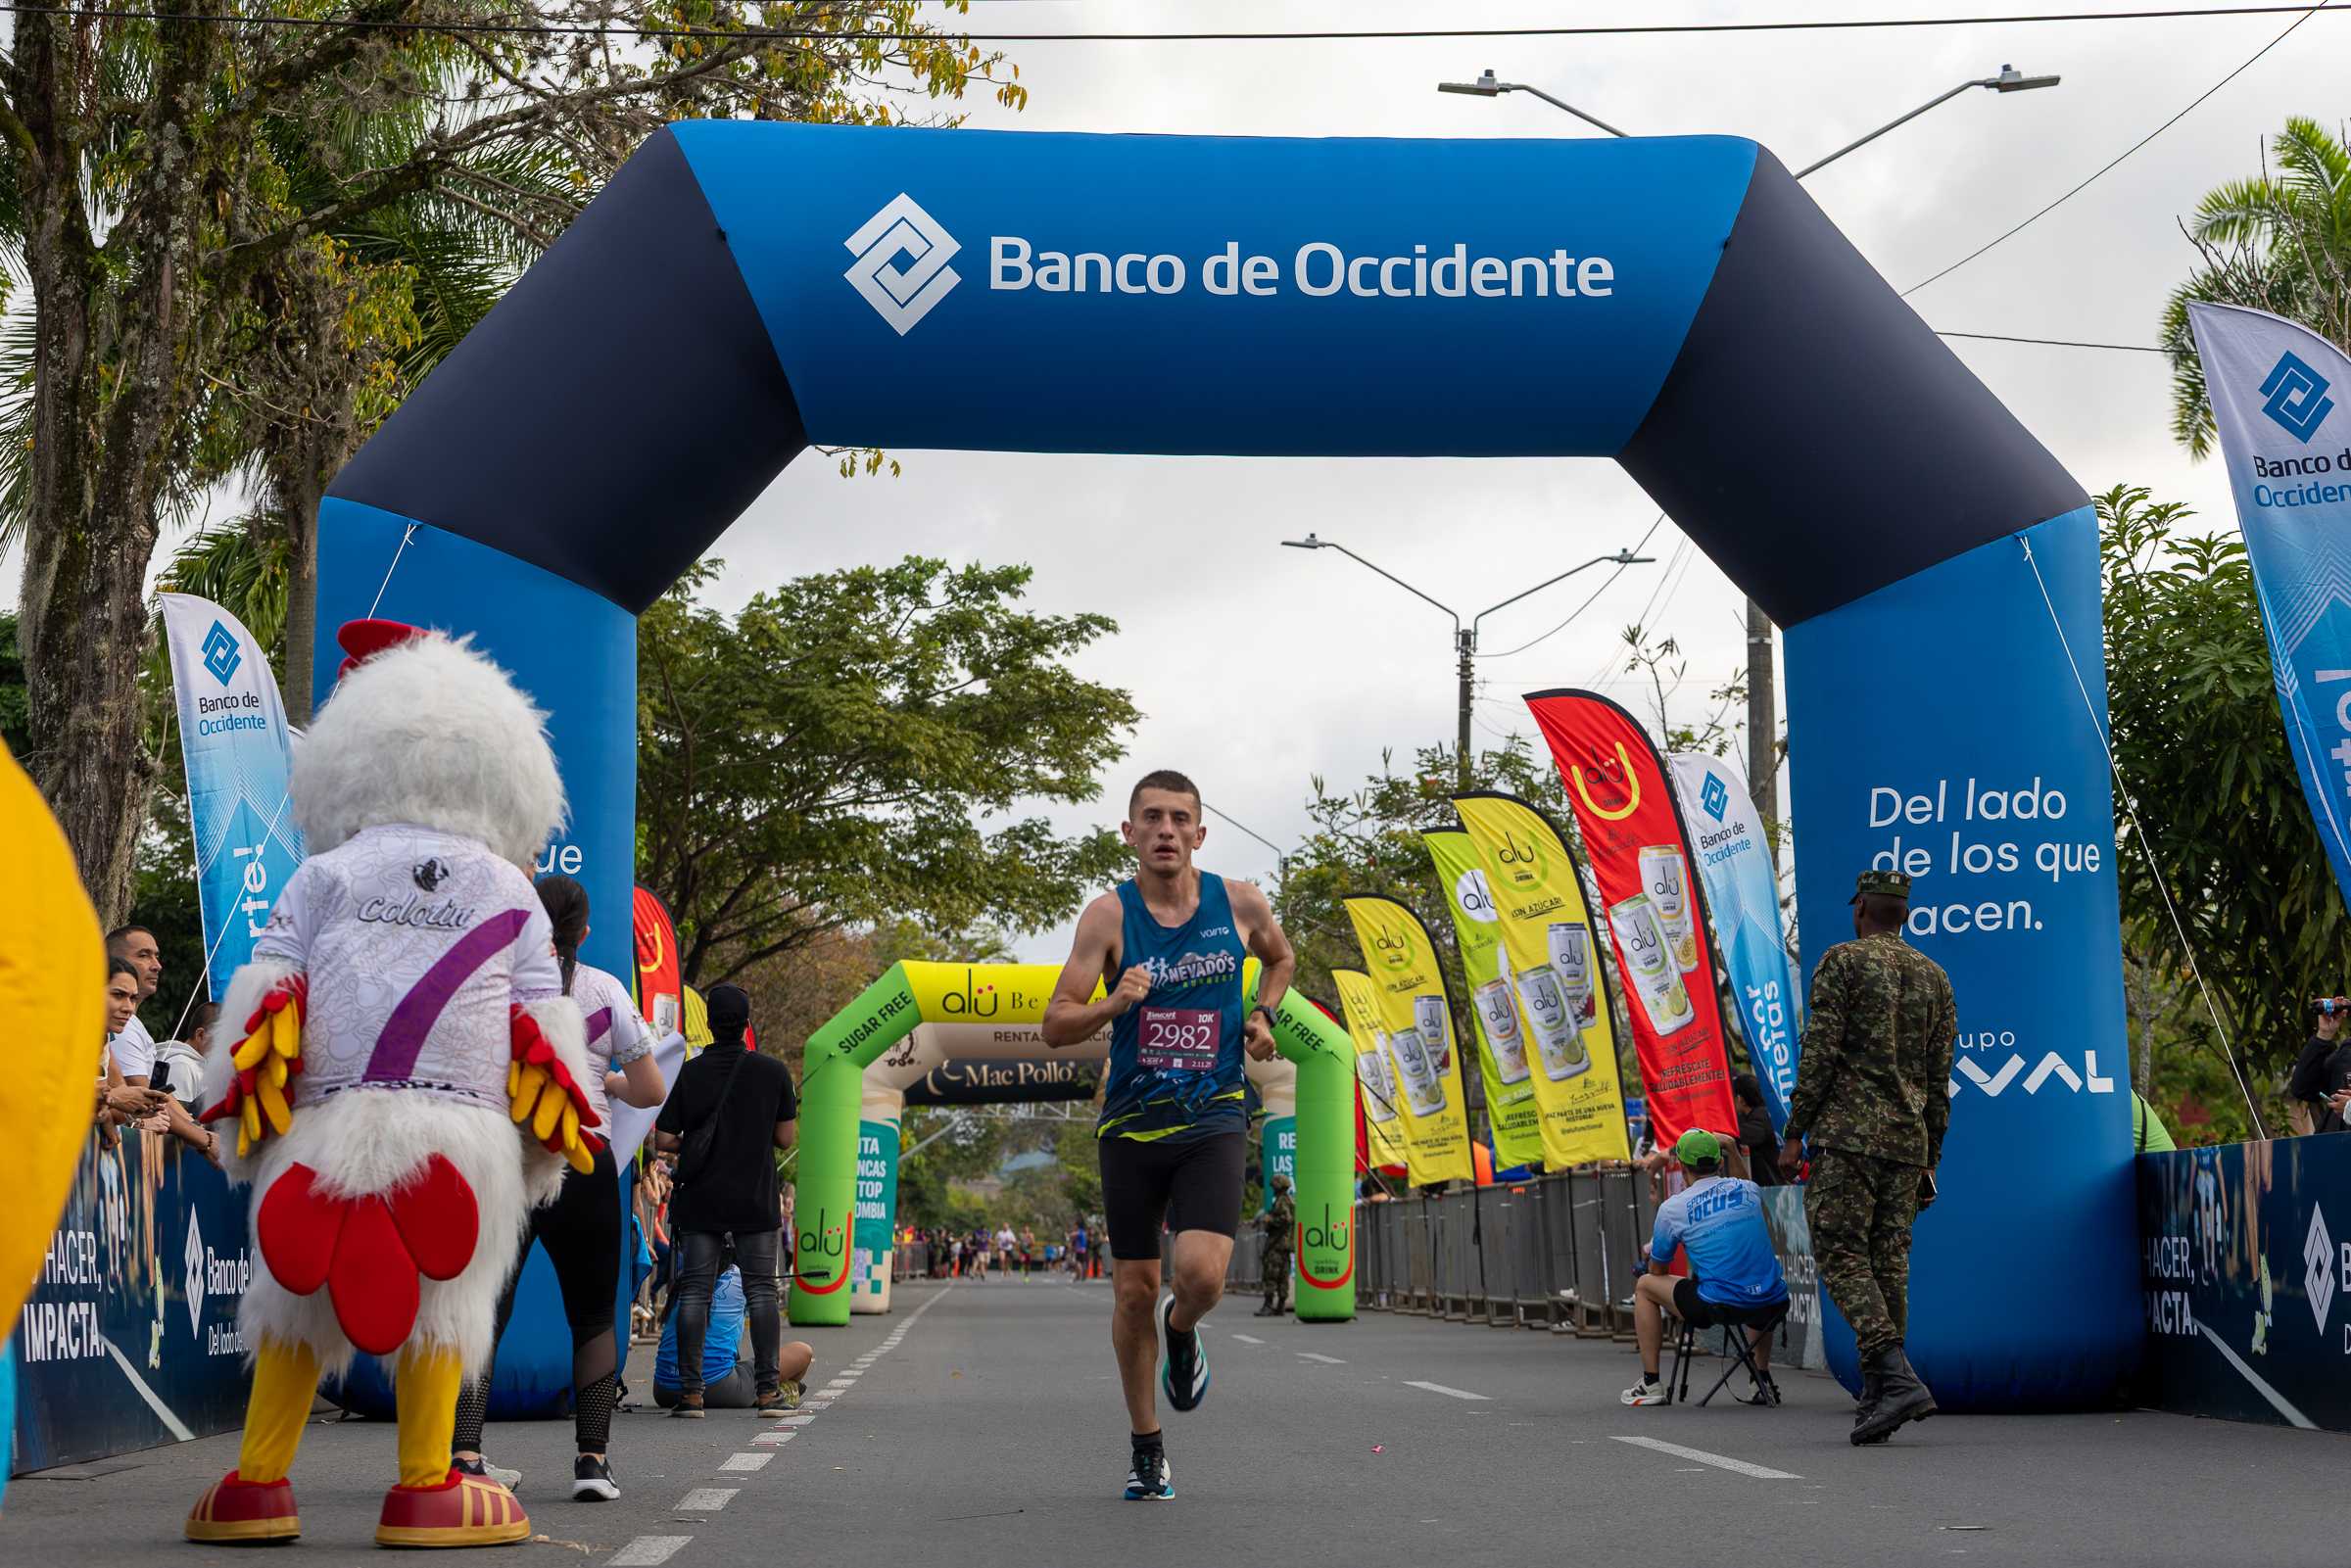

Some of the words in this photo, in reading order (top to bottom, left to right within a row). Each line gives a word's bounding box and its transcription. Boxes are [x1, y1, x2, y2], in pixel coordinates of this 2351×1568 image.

[989, 235, 1185, 295] Banco
[1202, 241, 1279, 296] de
[1295, 242, 1614, 298] Occidente
[2253, 454, 2330, 478] Banco
[2336, 448, 2351, 471] d
[2254, 481, 2351, 507] Occiden
[199, 696, 239, 714] Banco
[242, 691, 260, 708] de
[199, 714, 266, 736] Occidente
[1869, 780, 1946, 828] Del
[1965, 777, 2067, 821] lado
[1701, 829, 1732, 849] Banco
[1733, 822, 1745, 835] de
[535, 844, 583, 875] ue
[1872, 836, 1932, 878] de
[1950, 832, 2019, 875] los
[2035, 842, 2100, 882] que
[233, 844, 268, 937] rte!
[1899, 900, 2043, 936] acen.
[1169, 956, 1236, 983] NEVADO'S
[942, 968, 998, 1017] alü
[839, 1017, 882, 1055] SUGAR
[878, 990, 912, 1022] FREE
[1198, 1013, 1215, 1023] 10K
[1148, 1022, 1212, 1050] 2982
[1290, 1021, 1324, 1052] FREE
[1959, 1031, 2015, 1052] upo
[965, 1064, 1014, 1087] Mac
[1017, 1061, 1074, 1084] Pollo
[1278, 1132, 1296, 1150] RE
[856, 1160, 887, 1177] NCAS
[1272, 1155, 1293, 1172] LAS
[854, 1202, 887, 1219] OMBIA
[800, 1208, 843, 1257] alü
[1306, 1204, 1347, 1251] alü
[45, 1229, 102, 1293] HACER,
[207, 1246, 236, 1295] Banco
[238, 1247, 249, 1295] de
[2152, 1291, 2198, 1336] ACTA.
[24, 1302, 105, 1362] IMPACTA.
[208, 1325, 219, 1355] Del
[220, 1322, 234, 1355] lado
